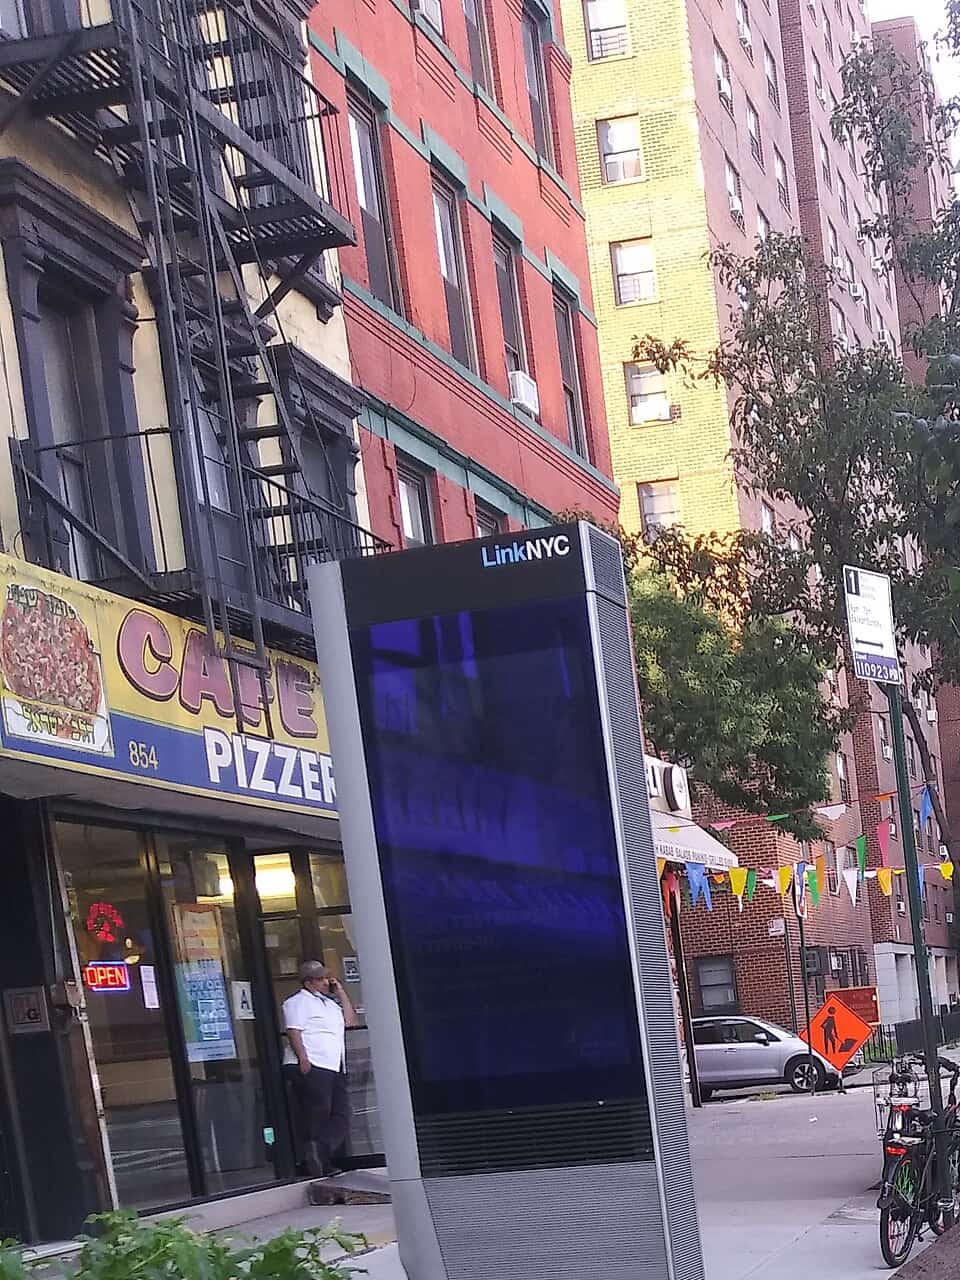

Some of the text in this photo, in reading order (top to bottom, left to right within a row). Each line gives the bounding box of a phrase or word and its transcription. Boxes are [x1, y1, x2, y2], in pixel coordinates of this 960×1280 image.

[482, 535, 569, 567] LinkNYC
[129, 740, 158, 770] 854
[86, 967, 125, 986] OPEN
[240, 988, 251, 1009] A
